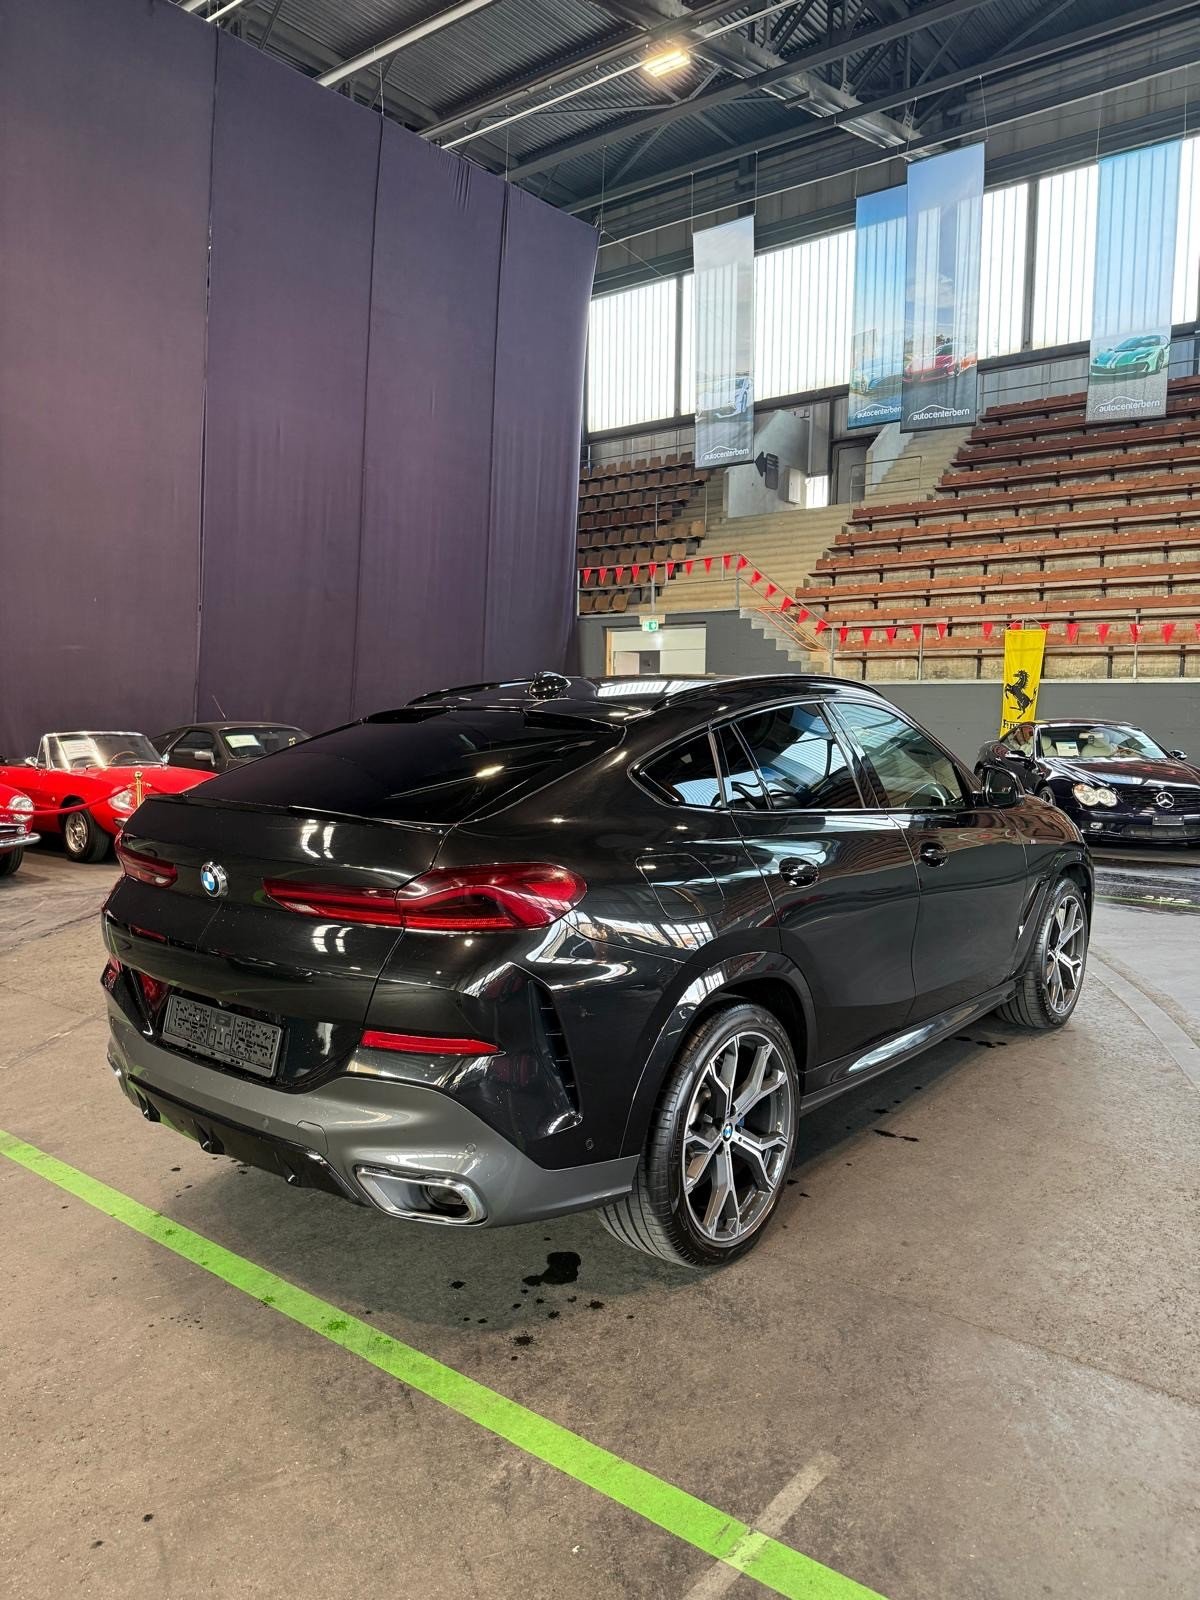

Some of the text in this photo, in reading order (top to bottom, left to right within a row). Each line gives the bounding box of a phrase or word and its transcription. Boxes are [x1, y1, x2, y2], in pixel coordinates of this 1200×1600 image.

[1099, 400, 1160, 412] autocenterbern
[913, 407, 970, 421] autocenterbern
[704, 447, 749, 460] autocenterbern
